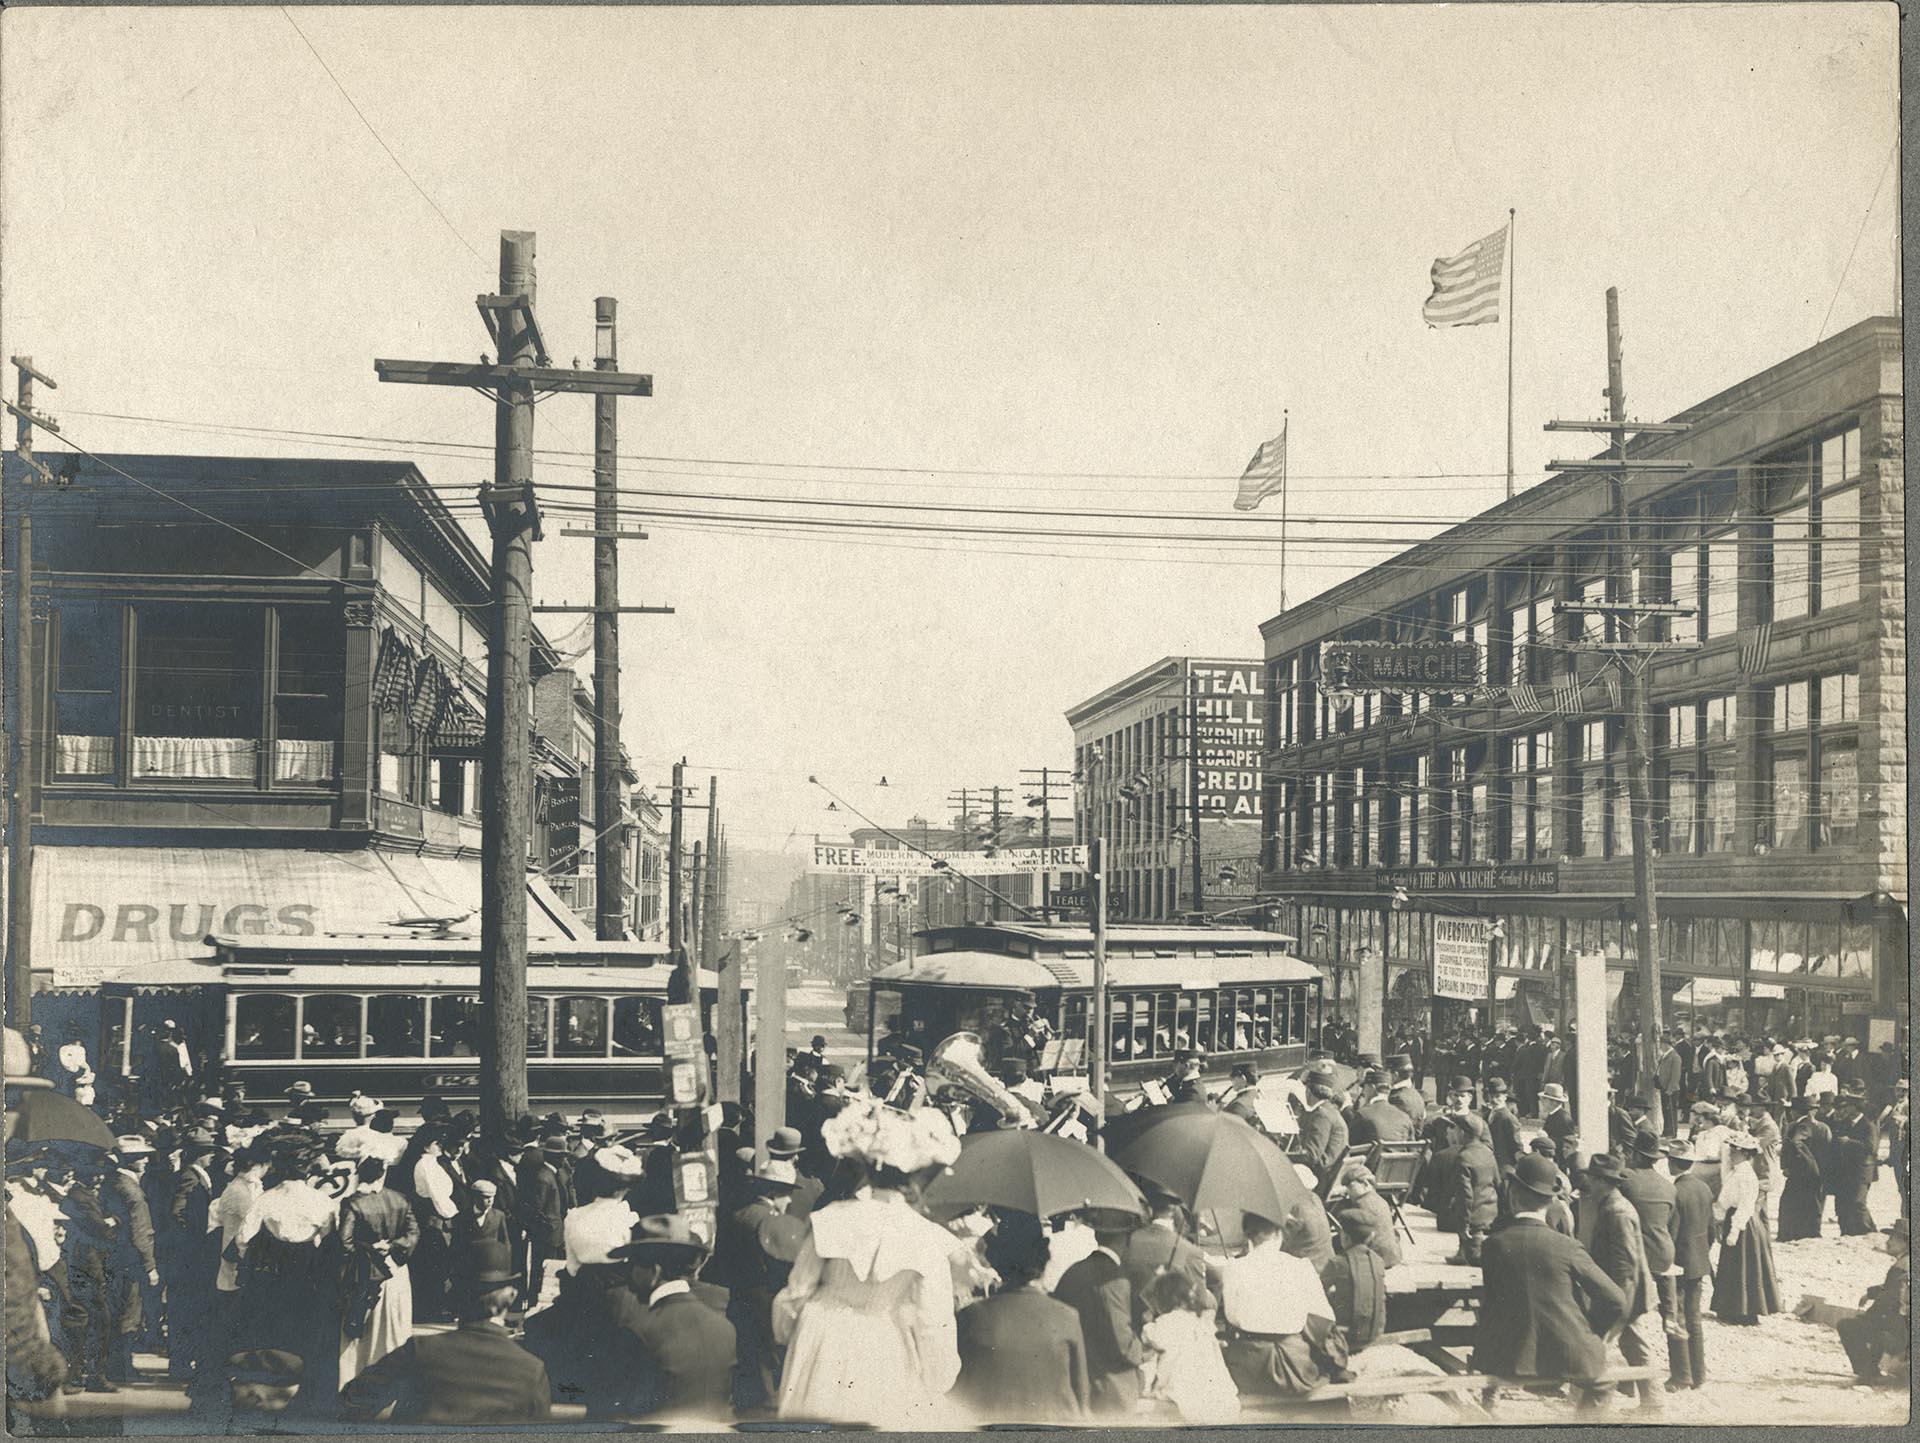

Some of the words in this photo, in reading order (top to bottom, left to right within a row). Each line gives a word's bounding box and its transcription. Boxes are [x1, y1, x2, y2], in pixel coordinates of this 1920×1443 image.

[1373, 652, 1472, 681] MARCHE
[1194, 669, 1264, 695] TEAL
[151, 703, 241, 719] DENTIST
[814, 846, 866, 866] FREE.
[867, 850, 914, 860] MODERN
[1041, 846, 1085, 865] FREE.
[1419, 871, 1437, 889] THE
[1438, 871, 1457, 889] BON
[1538, 871, 1554, 886] 1435
[57, 903, 319, 943] DRUGS
